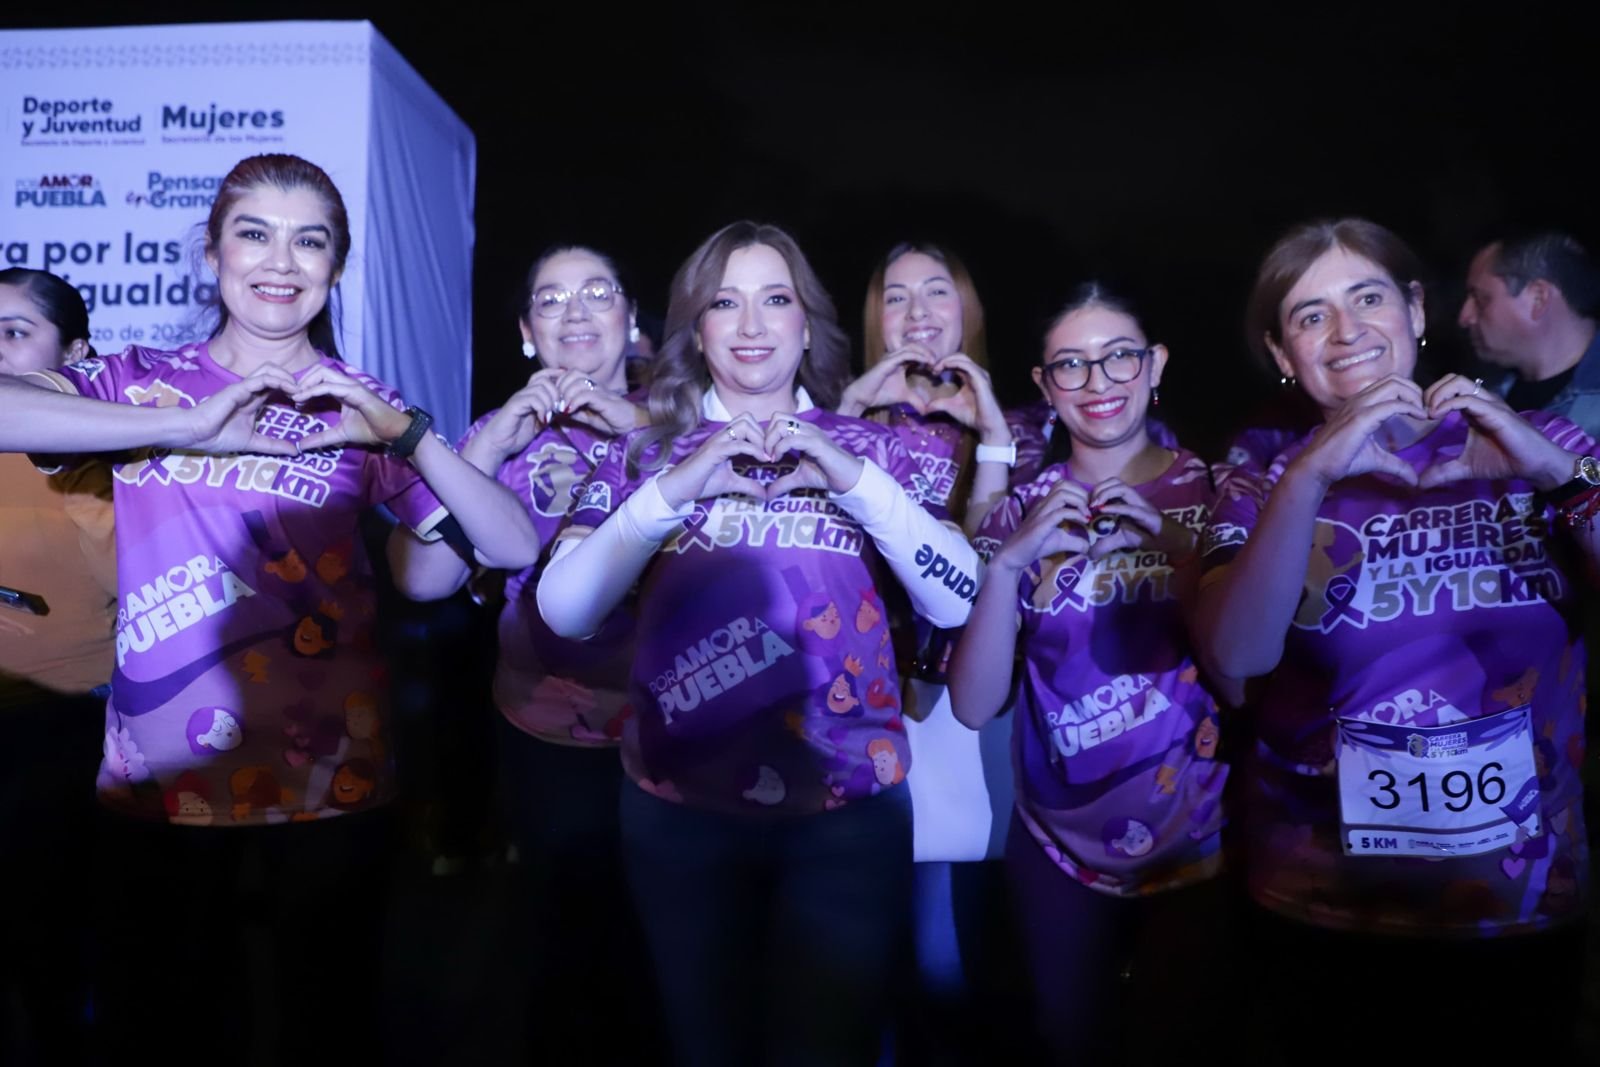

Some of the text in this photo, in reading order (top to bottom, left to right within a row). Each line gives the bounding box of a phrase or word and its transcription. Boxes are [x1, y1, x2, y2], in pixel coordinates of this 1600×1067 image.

[22, 115, 141, 137] y Juventud
[23, 96, 113, 117] Deporte
[162, 103, 284, 134] Mujeres
[15, 190, 107, 208] PUEBLA
[44, 241, 110, 272] por
[125, 232, 181, 264] las
[119, 324, 144, 342] de
[1363, 495, 1518, 537] CARRERA
[1366, 516, 1547, 563] MUJERES
[125, 554, 229, 619] AMOR A
[1388, 561, 1416, 578] LA
[116, 570, 257, 668] PUEBLA
[674, 616, 756, 680] AMOR
[754, 616, 769, 635] A
[657, 629, 796, 726] PUEBLA
[1057, 673, 1139, 726] AMOR
[1138, 673, 1153, 690] A
[1051, 687, 1172, 758] UEBLA
[1367, 761, 1506, 813] 3196
[1361, 836, 1370, 849] 5
[1373, 837, 1398, 849] KM
